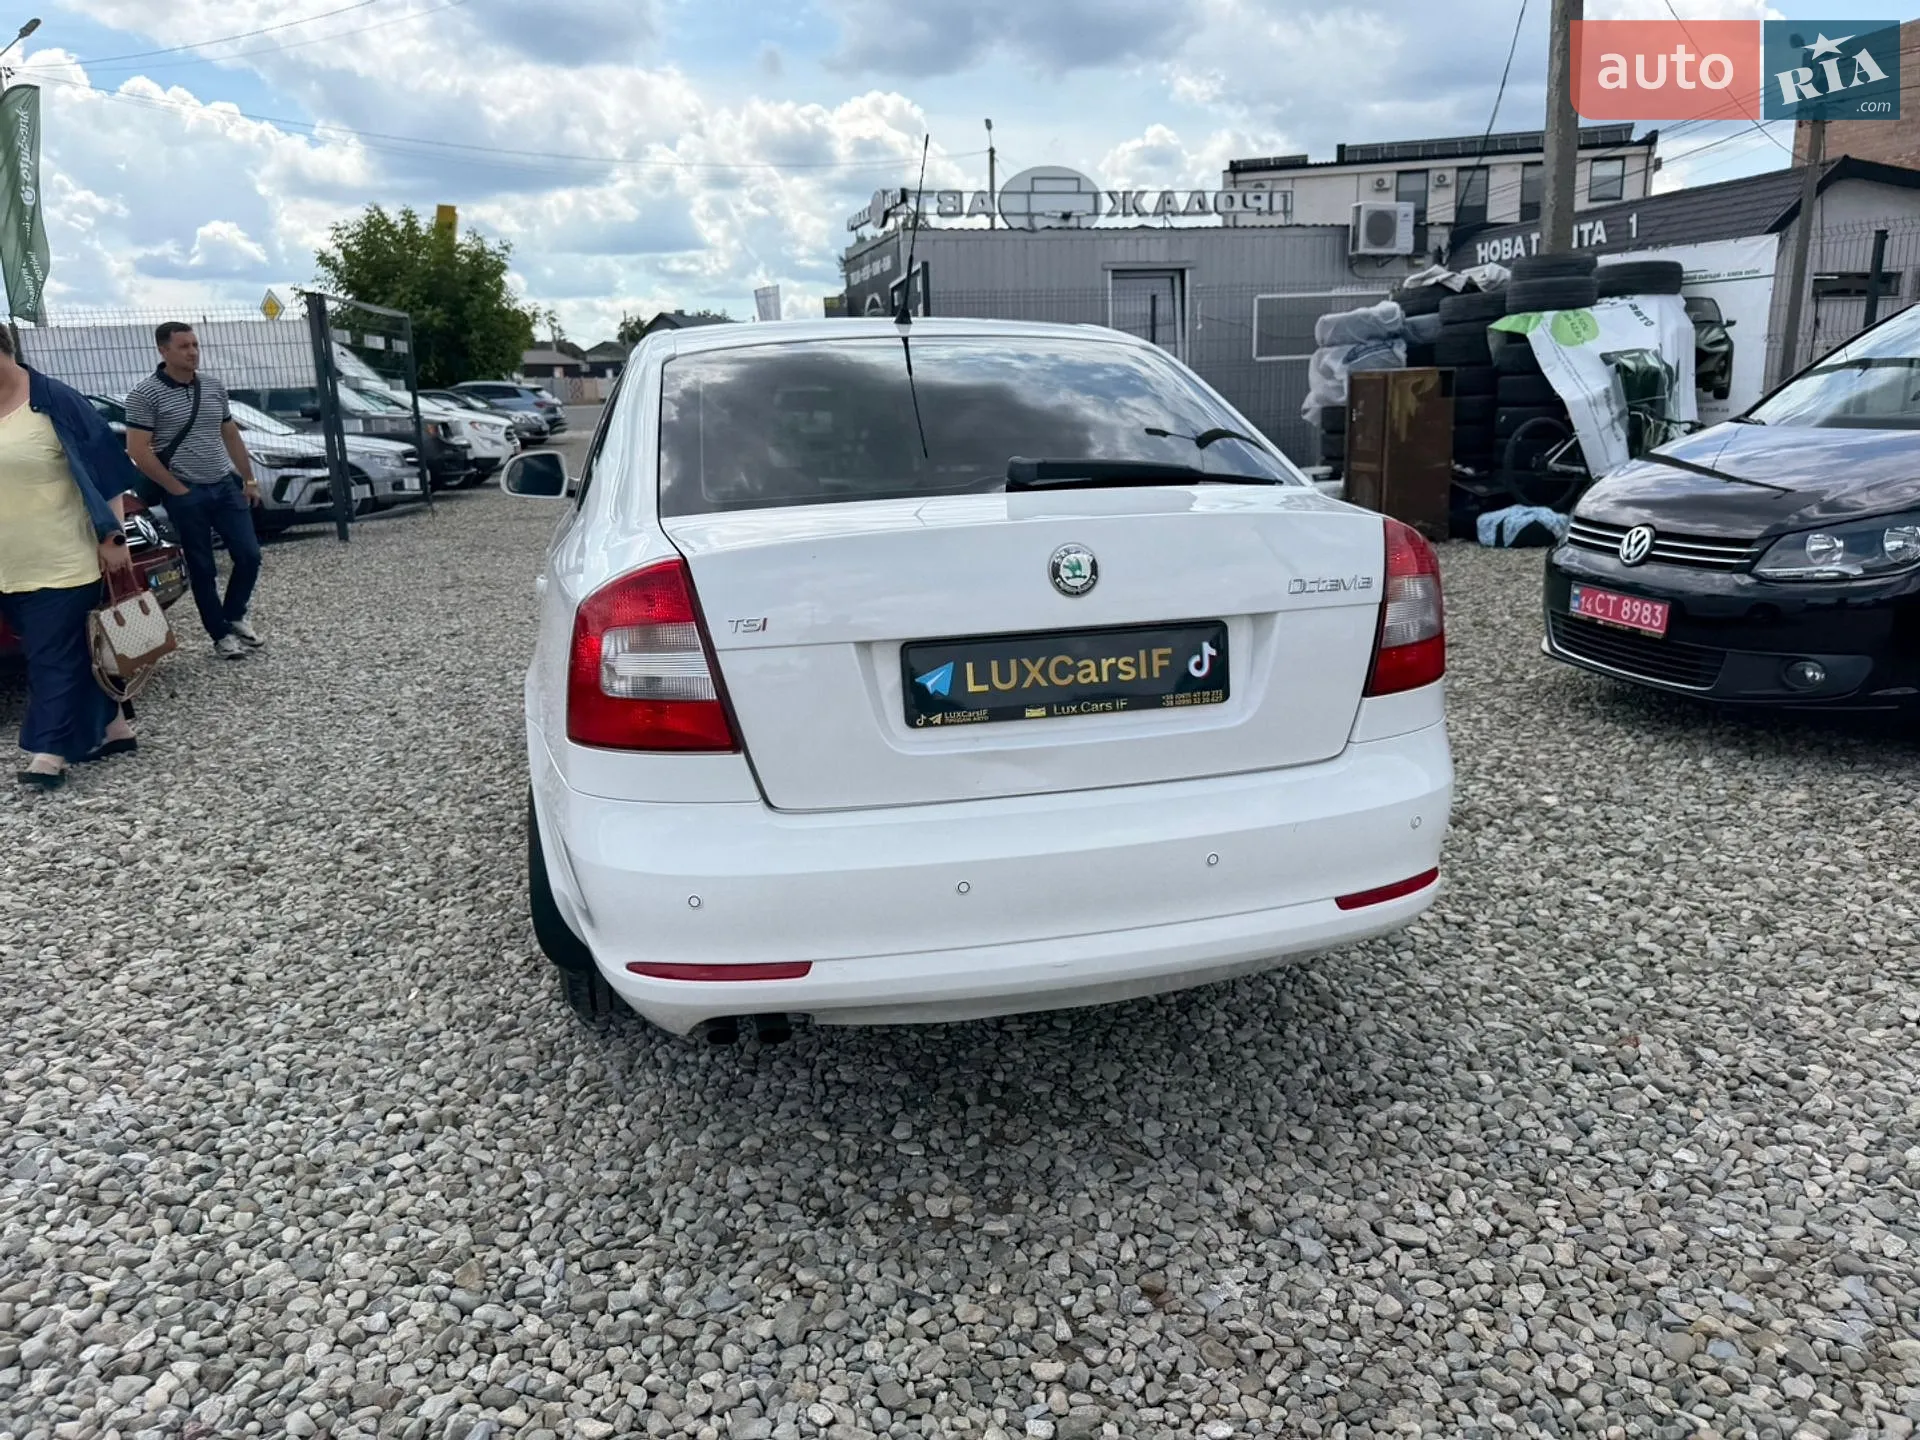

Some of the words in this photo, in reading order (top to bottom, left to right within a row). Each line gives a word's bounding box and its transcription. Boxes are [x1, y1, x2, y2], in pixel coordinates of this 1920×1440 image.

[1476, 235, 1526, 264] НОВА
[1530, 220, 1607, 256] ПТА
[1628, 213, 1638, 238] 1
[728, 617, 768, 633] TSI
[1621, 598, 1663, 627] 8983
[965, 647, 1172, 693] LUXCarsIF
[1053, 703, 1077, 716] Lux
[1080, 701, 1113, 713] Cars
[1116, 698, 1128, 710] IF
